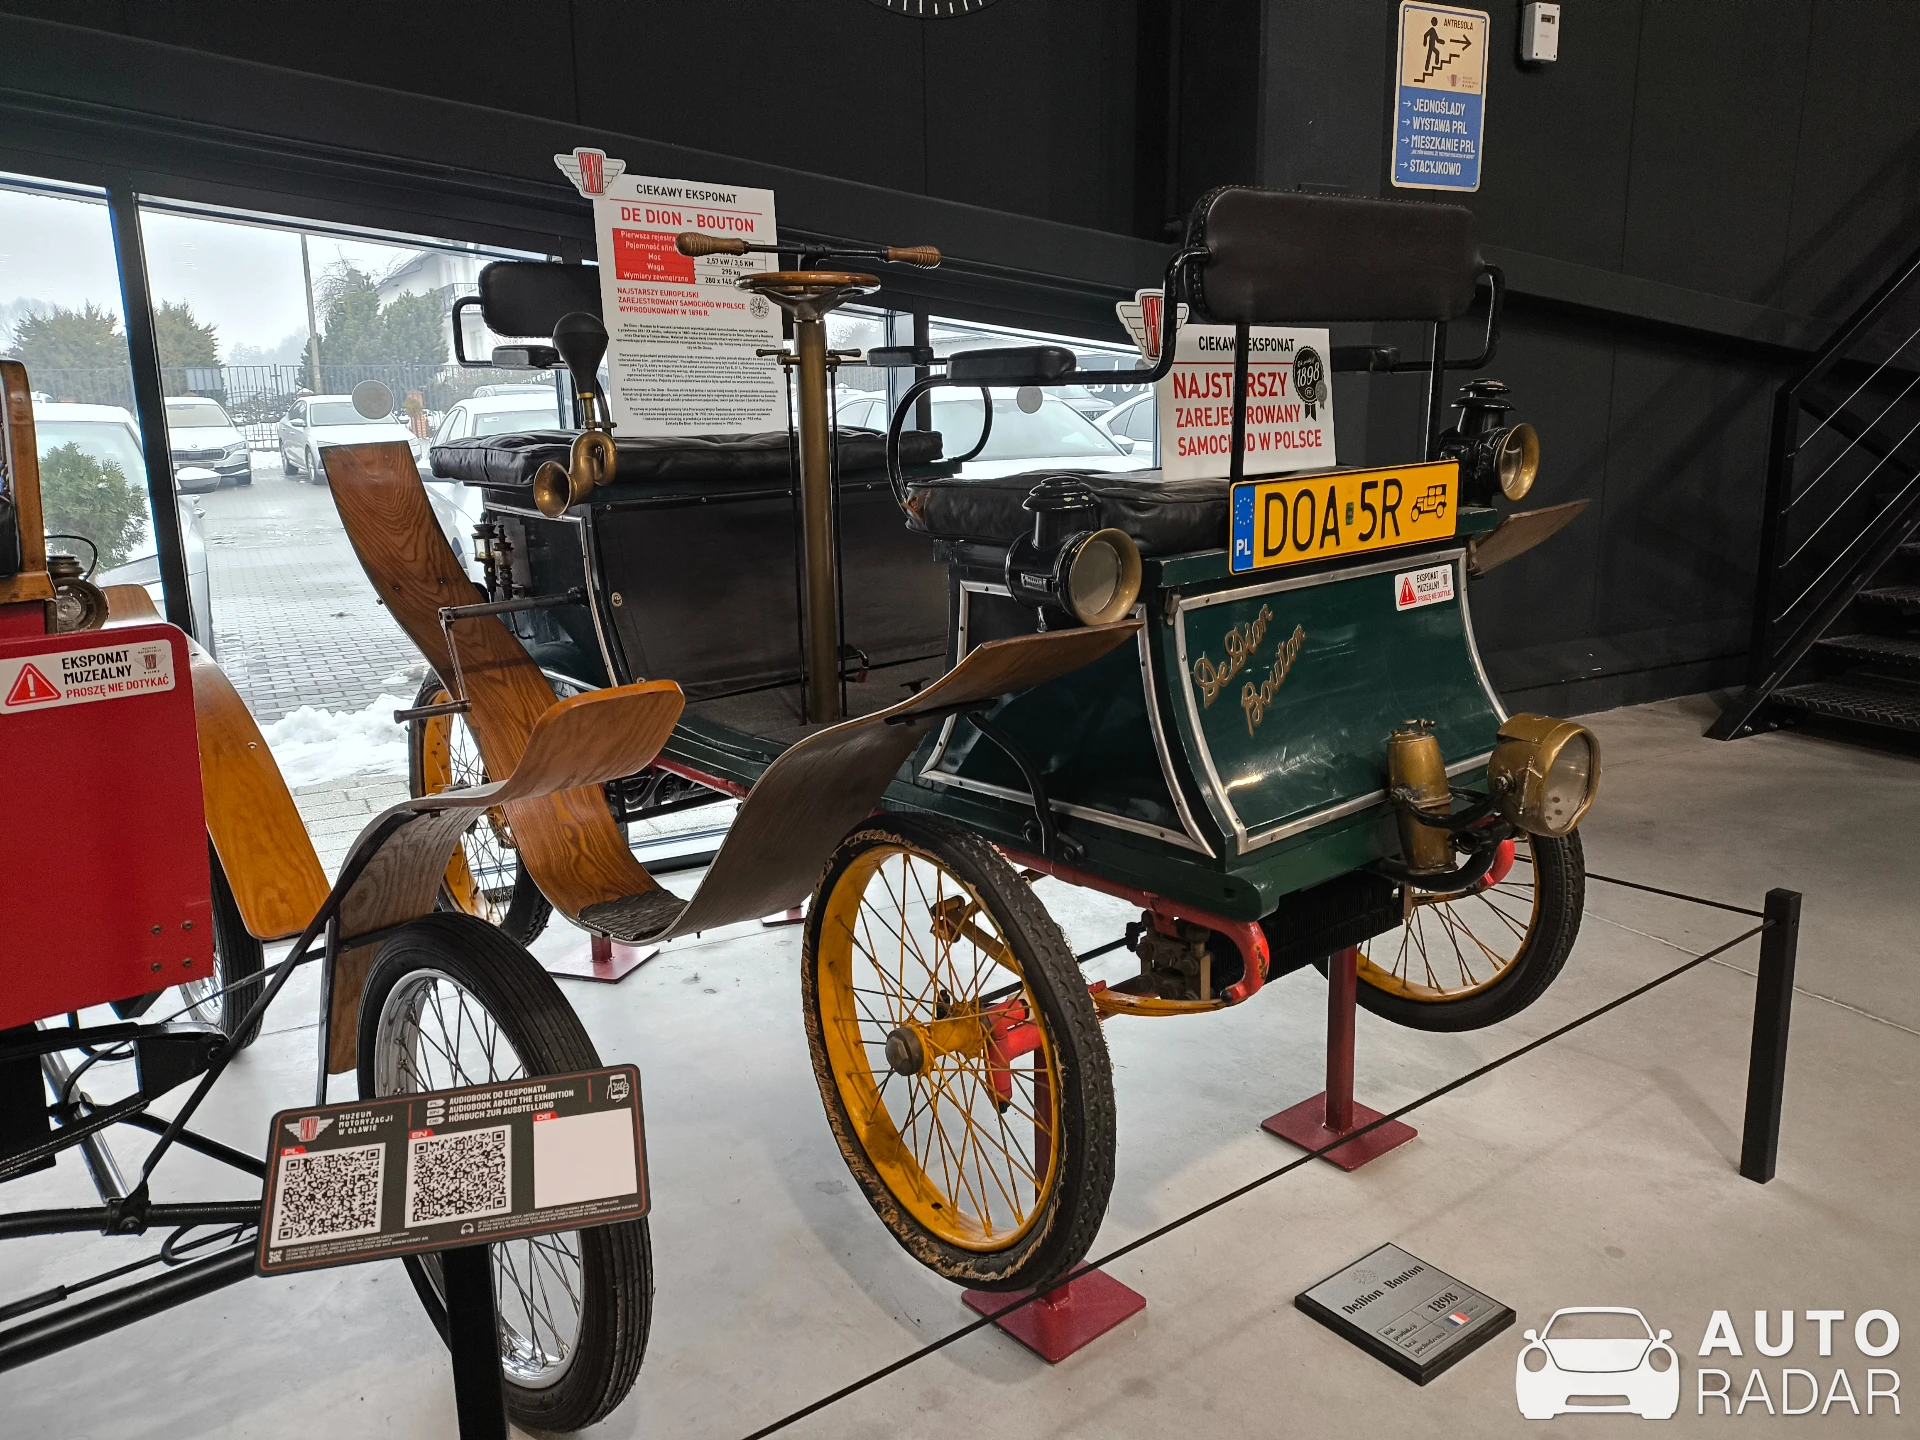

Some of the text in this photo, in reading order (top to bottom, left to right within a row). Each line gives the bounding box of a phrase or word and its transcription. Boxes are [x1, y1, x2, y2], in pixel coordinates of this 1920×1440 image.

[1443, 18, 1474, 31] ANTRESOLA
[1413, 97, 1466, 116] JEDNOŚLADY
[1412, 117, 1468, 135] WYSTAWA PRL
[1410, 135, 1476, 153] MIESZKANIE PRL
[1409, 159, 1462, 176] STACYJKOWO
[636, 184, 737, 204] CIEKAWY EKSPONAT
[621, 207, 642, 223] DE
[645, 209, 682, 226] DION
[697, 213, 755, 233] BOUTON
[620, 230, 676, 242] Pierwsza rejestra
[625, 241, 660, 250] Pojemność
[623, 271, 652, 280] Wymiary
[646, 263, 665, 272] Waga
[617, 287, 699, 298] NAJSTARSZY EUROPEJSKI
[618, 296, 679, 306] ZAREJESTROWANY
[680, 299, 715, 308] SAMOCHÓD
[722, 302, 746, 310] POLSCE
[619, 305, 680, 316] WYPRODUKOWANY
[1199, 336, 1237, 351] CIEKAW
[1297, 361, 1320, 388] 1898
[1173, 371, 1288, 399] NAJSTRSZY
[1175, 404, 1301, 428] ZAREJESROWANY
[1258, 432, 1271, 450] W
[1274, 429, 1322, 450] POLSCE
[1263, 477, 1404, 558] DOA 5R
[1236, 538, 1251, 557] PL
[1416, 570, 1439, 583] EKSPONAT
[61, 650, 130, 670] EKSPONAT
[64, 664, 133, 685] MUZEALNY
[1241, 624, 1307, 737] Bouton
[66, 673, 170, 698] PROSZĘ NIE DOTYKAĆ
[449, 1092, 492, 1105] AUDIOBOOK
[492, 1090, 503, 1099] DO
[504, 1085, 547, 1098] EKSPONATU
[449, 1101, 492, 1114] AUDIOBOOK
[493, 1098, 517, 1108] ABOUT
[518, 1096, 533, 1104] THE
[534, 1089, 574, 1102] EXHIBITION
[339, 1111, 372, 1121] MUZEUM
[448, 1109, 485, 1123] HÖRBUCH
[486, 1108, 501, 1117] ZUR
[502, 1101, 554, 1115] AUSSTELLUNG
[338, 1115, 394, 1128] MOTORYZACJI
[347, 1124, 377, 1134] OŁAWIE
[410, 1131, 428, 1139] EN
[284, 1148, 299, 1156] PL
[1341, 1289, 1385, 1315] DeDion
[1383, 1265, 1424, 1289] Bouton
[1427, 1292, 1459, 1313] 1898
